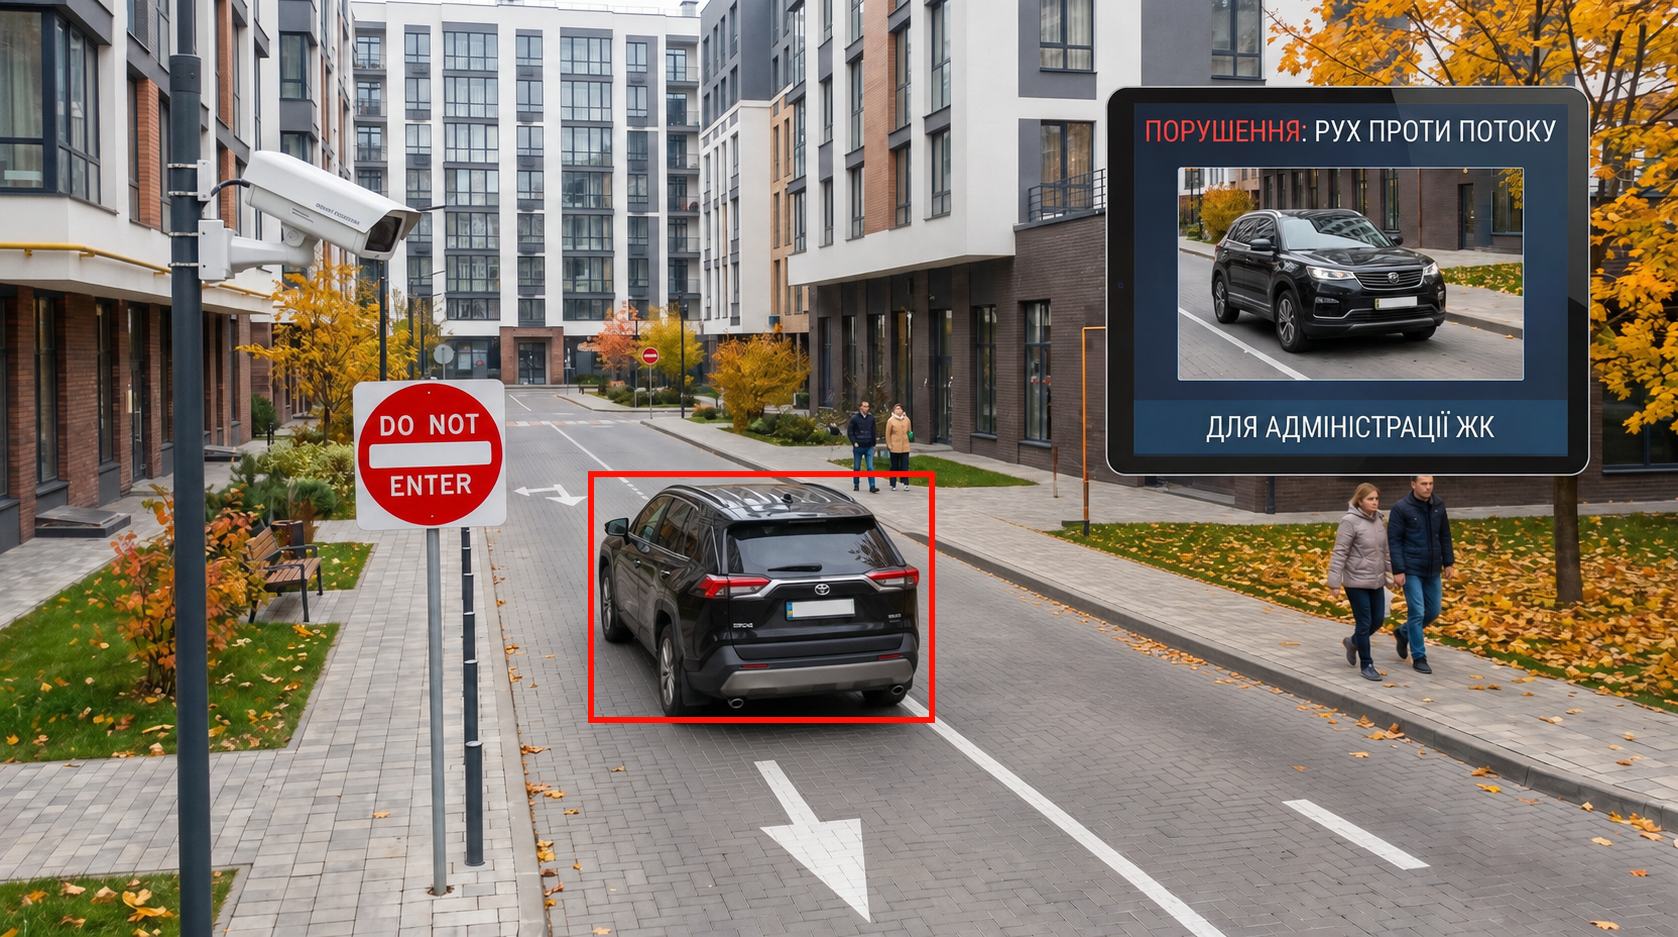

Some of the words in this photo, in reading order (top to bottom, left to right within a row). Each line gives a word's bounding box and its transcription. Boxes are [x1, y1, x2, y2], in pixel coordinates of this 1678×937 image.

[1144, 119, 1308, 143] ПОРУШЕННЯ:
[1314, 119, 1361, 143] РУХ
[1369, 119, 1452, 143] ПРОТИ
[1459, 119, 1557, 143] ПОТОКУ
[380, 415, 414, 436] DO
[429, 413, 479, 435] NOT
[1206, 415, 1258, 443] ДЛЯ
[1265, 410, 1451, 443] АДМІНІСТРАЦІЇ
[1456, 415, 1495, 438] ЖК
[390, 473, 472, 497] ENTER
